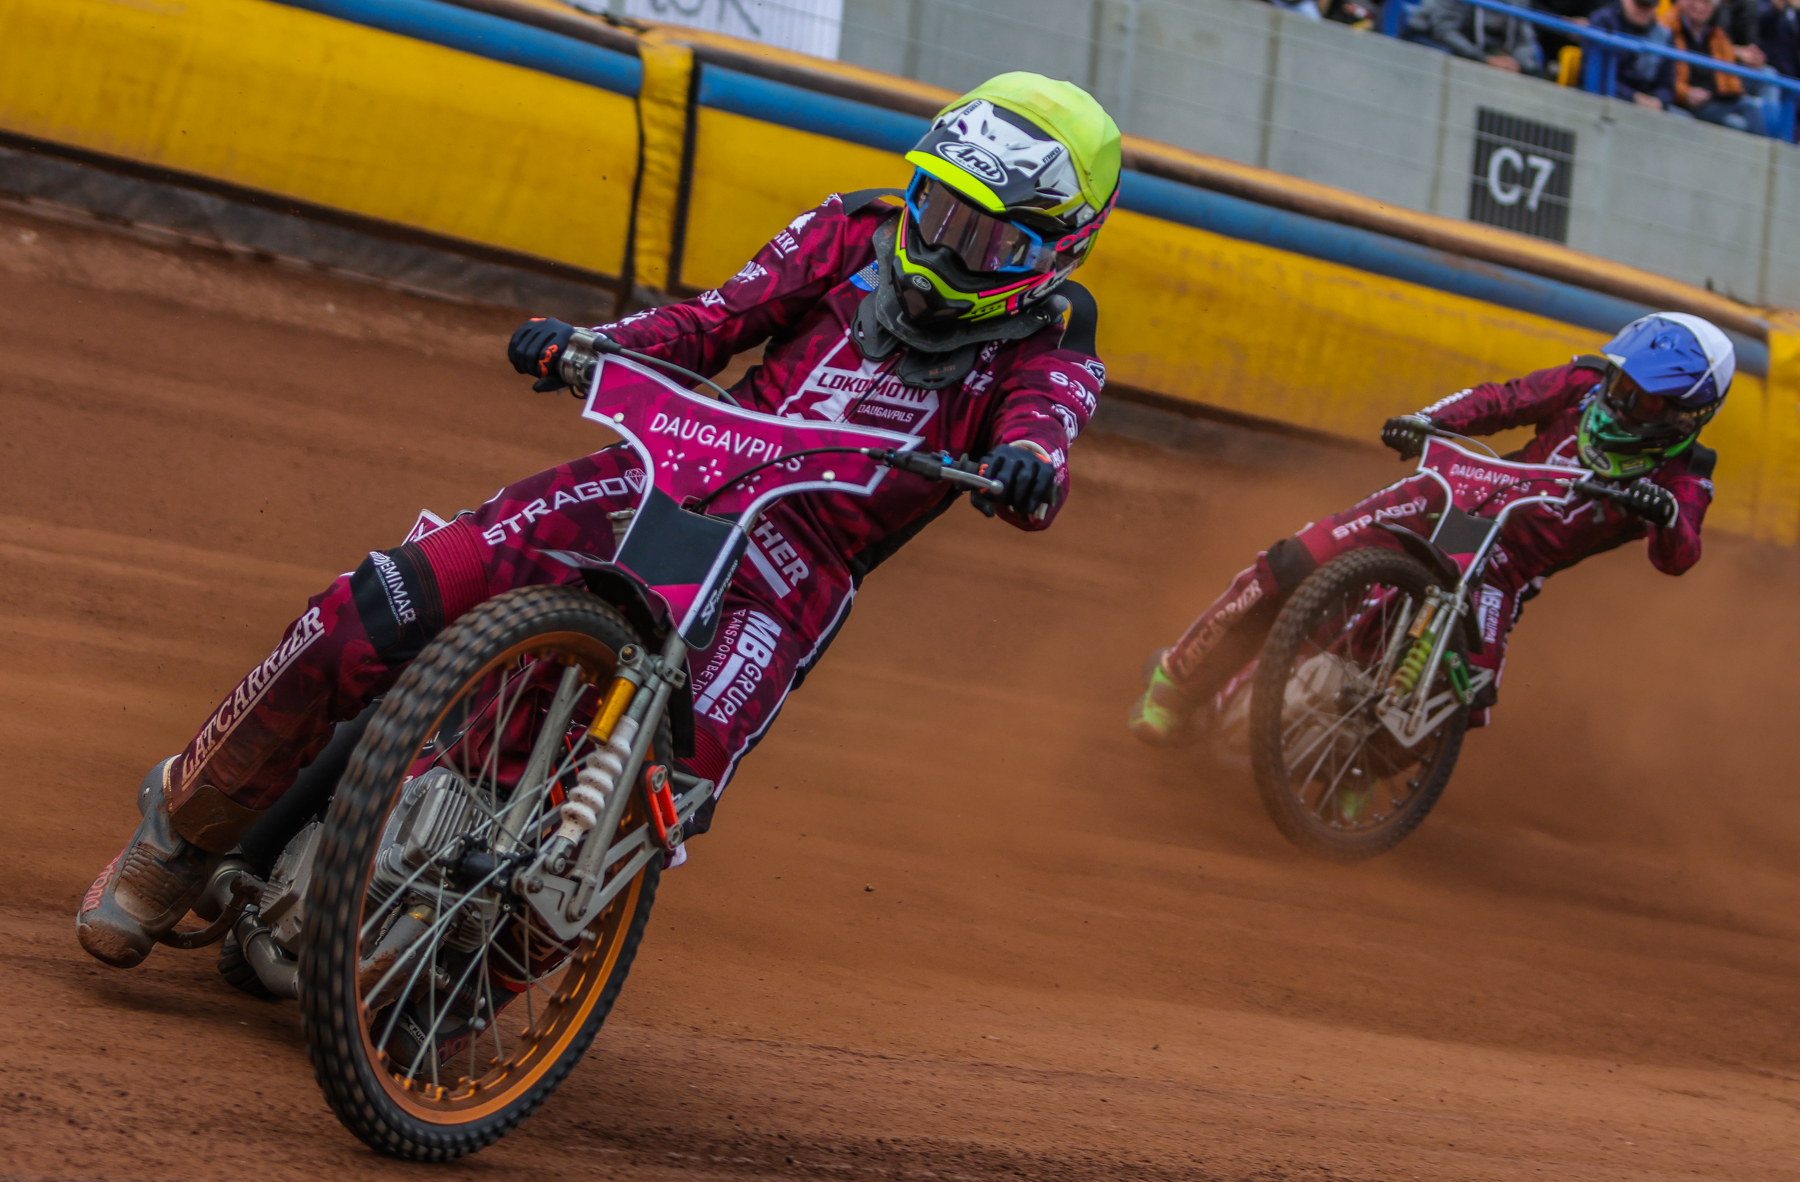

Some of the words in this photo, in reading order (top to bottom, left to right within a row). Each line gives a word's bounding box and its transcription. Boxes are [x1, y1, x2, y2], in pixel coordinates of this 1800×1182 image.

[943, 145, 1000, 187] Arai
[1487, 146, 1554, 212] C7
[817, 372, 932, 403] LOKOMOTIV
[857, 403, 914, 423] DAUGAVPILS
[650, 413, 804, 472] DAUGAVPILS
[1449, 464, 1532, 492] DAUGAVPILS
[737, 610, 783, 669] MB
[181, 606, 324, 787] LATCARRIER
[709, 663, 763, 724] GRUPA
